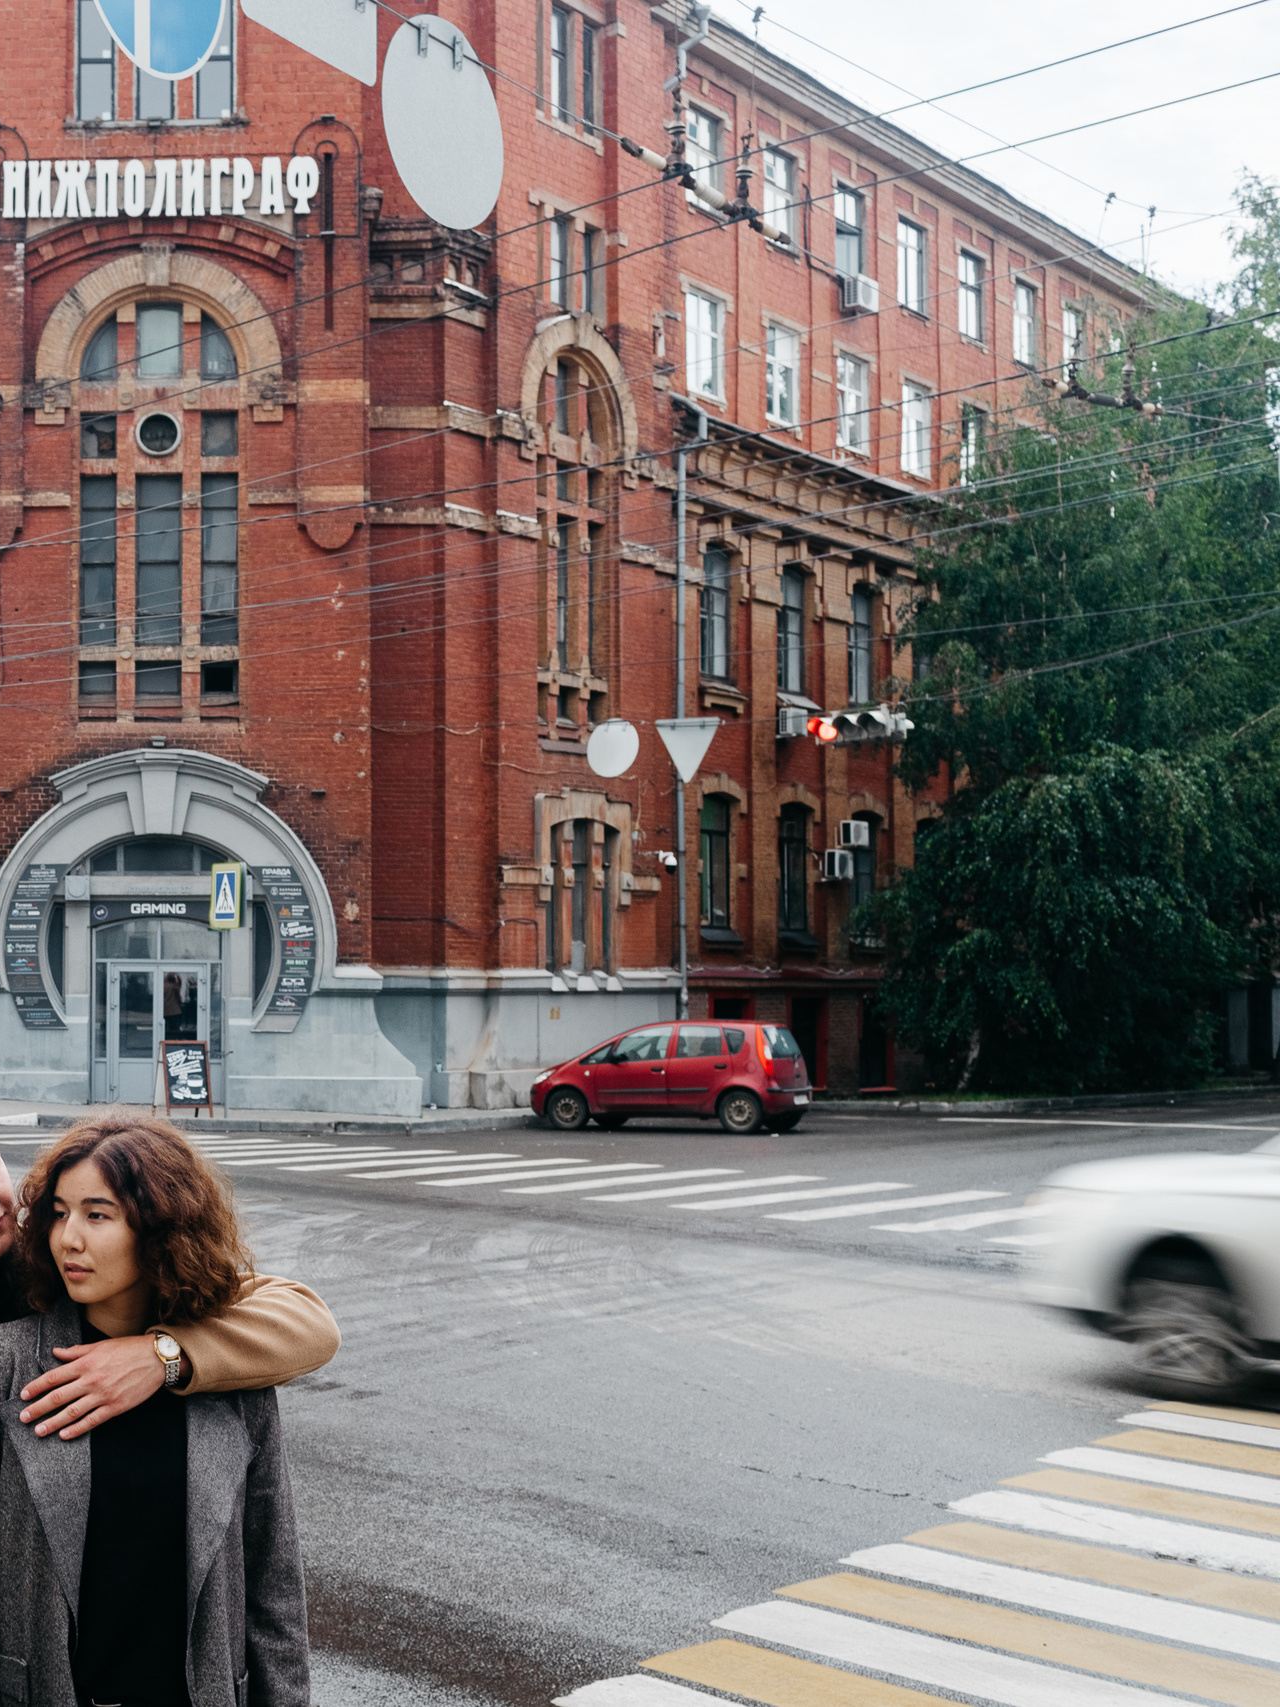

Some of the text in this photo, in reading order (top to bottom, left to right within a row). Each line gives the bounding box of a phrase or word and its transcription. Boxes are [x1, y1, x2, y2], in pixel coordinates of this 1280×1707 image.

[2, 156, 319, 218] НИЖПОЛИГРАФ
[262, 868, 291, 876] ПРАВДА
[130, 903, 186, 914] GAMING
